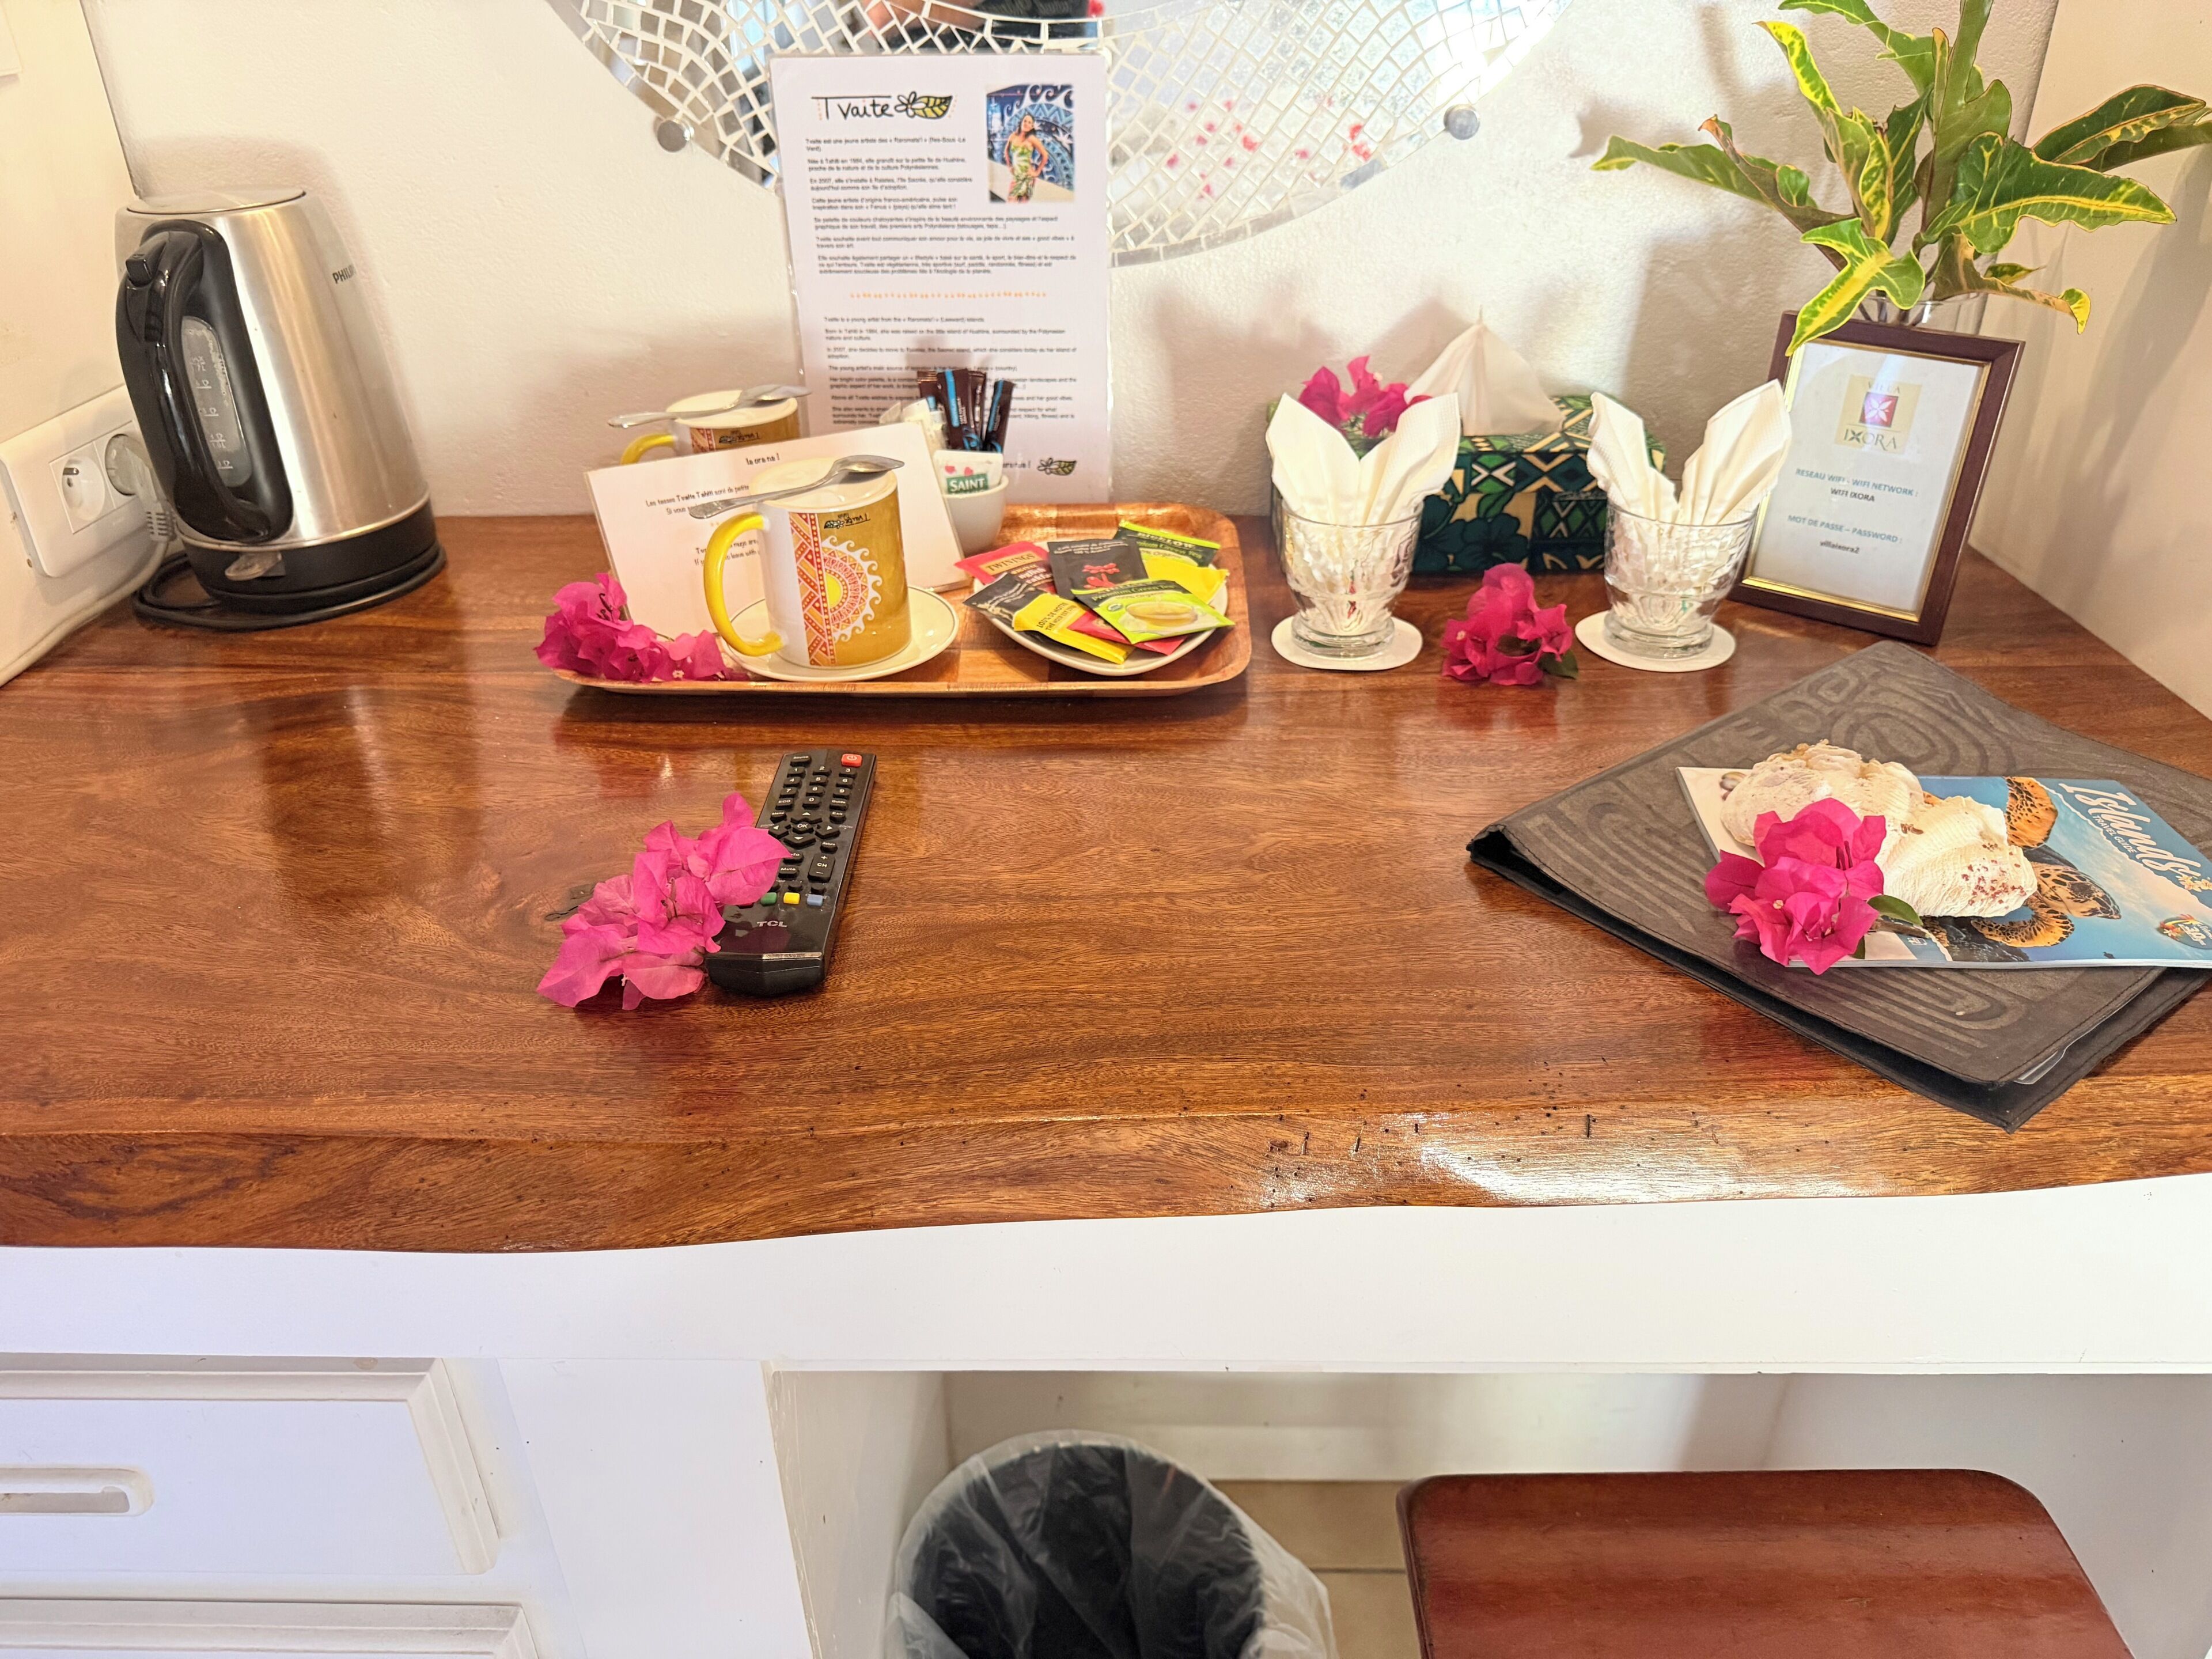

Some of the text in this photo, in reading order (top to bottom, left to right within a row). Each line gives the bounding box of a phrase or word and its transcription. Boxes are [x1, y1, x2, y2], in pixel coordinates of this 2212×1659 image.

[1844, 429, 1897, 451] IXORA
[950, 478, 986, 492] SAINT
[1796, 468, 1825, 480] RESEAU
[1852, 479, 1870, 488] WIFI
[1872, 482, 1914, 496] NETWORK
[1831, 488, 1875, 502] WIFI IXORA
[1788, 515, 1806, 524] MOT
[1820, 521, 1844, 532] PASSE
[1852, 528, 1898, 543] PASSWORD
[986, 553, 1036, 571] TWININGS
[2058, 783, 2202, 878] Islands
[2092, 815, 2138, 854] TRAVEL GUIDE
